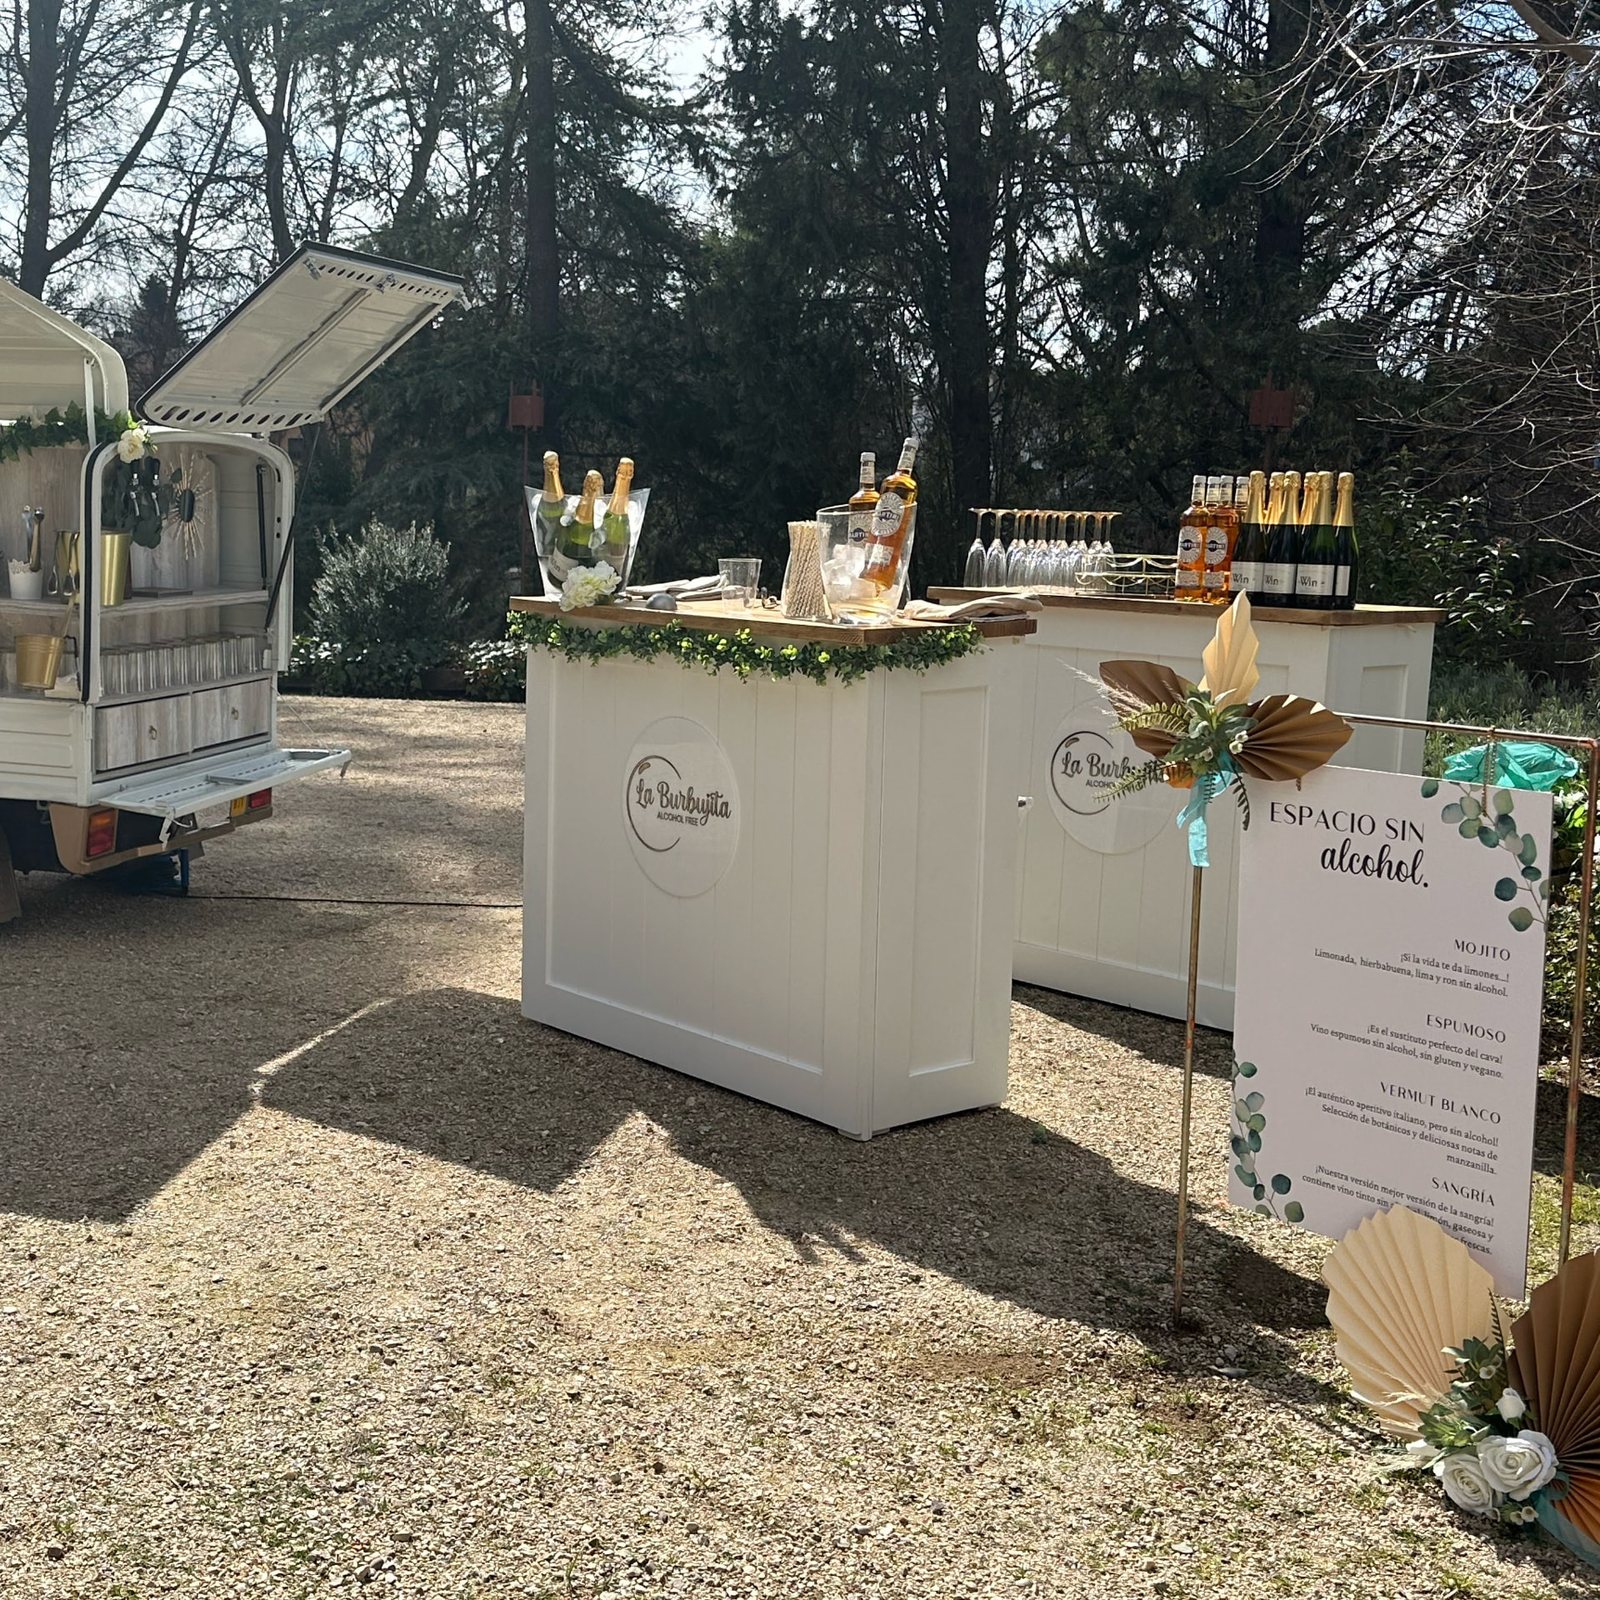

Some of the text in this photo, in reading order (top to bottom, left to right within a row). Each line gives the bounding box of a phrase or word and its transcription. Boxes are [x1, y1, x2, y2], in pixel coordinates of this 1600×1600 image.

[1232, 573, 1249, 584] Win
[1300, 576, 1318, 587] Win
[1061, 751, 1083, 778] La
[636, 779, 731, 826] La Burbujita
[657, 811, 699, 827] ALCOHOL FREE
[1269, 801, 1424, 844] ESPACIO SIN
[1321, 838, 1429, 888] alcohol.
[1412, 954, 1421, 965] la
[1422, 956, 1440, 968] vida
[1441, 961, 1450, 970] te
[1451, 961, 1463, 973] da
[1454, 939, 1511, 962] MOJITO
[1314, 948, 1509, 997] Limonada, hierbabuena, lima y ron sin alcohol.
[1380, 1026, 1389, 1036] el
[1389, 1029, 1427, 1046] sustituto
[1428, 1038, 1464, 1055] perfecto
[1464, 1045, 1479, 1058] del
[1479, 1052, 1504, 1065] cava!
[1426, 1013, 1506, 1044] ESPUMOSO
[1311, 1023, 1504, 1079] Vino espumoso sin alcohol, sin gluten y vegano.
[1317, 1090, 1355, 1107] auténtico
[1356, 1100, 1392, 1118] aperitivo
[1393, 1109, 1427, 1128] italiano,
[1428, 1121, 1448, 1134] pero
[1449, 1126, 1462, 1137] sin
[1463, 1130, 1499, 1147] alcohol!
[1380, 1081, 1501, 1125] VERMUT BLANCO
[1322, 1104, 1498, 1161] Selección de botánicos y deliciosas notas de
[1446, 1153, 1497, 1175] manzanilla.
[1302, 1174, 1336, 1190] contiene
[1337, 1184, 1354, 1196] vino
[1355, 1190, 1376, 1204] tinto
[1376, 1198, 1389, 1208] sin
[1452, 1222, 1487, 1239] gaseosa
[1487, 1233, 1494, 1242] y
[1350, 1175, 1379, 1191] versión
[1380, 1185, 1404, 1199] mejor
[1406, 1193, 1436, 1209] versión
[1438, 1202, 1448, 1213] de
[1449, 1204, 1458, 1215] la
[1431, 1176, 1496, 1207] SANGRÍA
